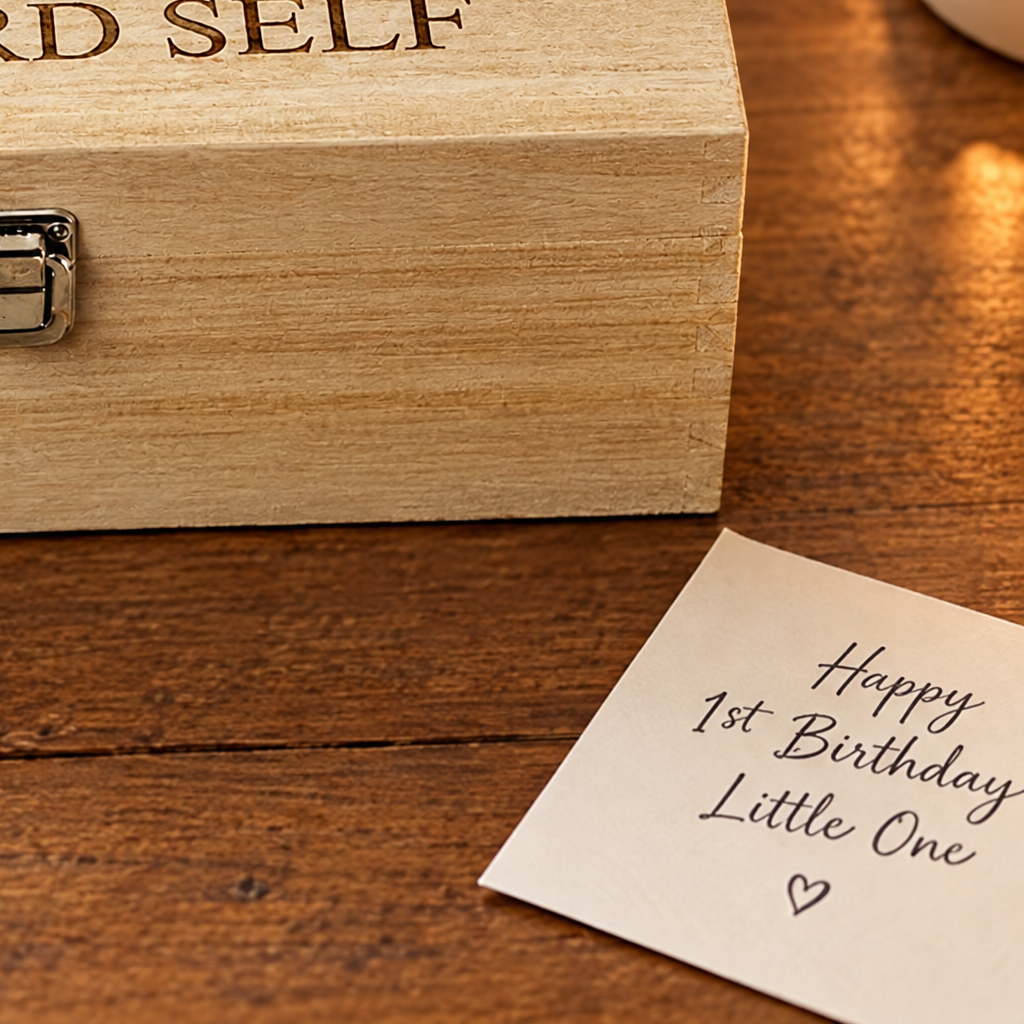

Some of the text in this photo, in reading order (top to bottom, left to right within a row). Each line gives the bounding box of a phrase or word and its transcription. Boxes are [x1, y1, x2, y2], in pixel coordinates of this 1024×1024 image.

[810, 641, 986, 735] Happy
[691, 690, 1024, 826] 1st Birthday
[698, 772, 977, 866] Little One
